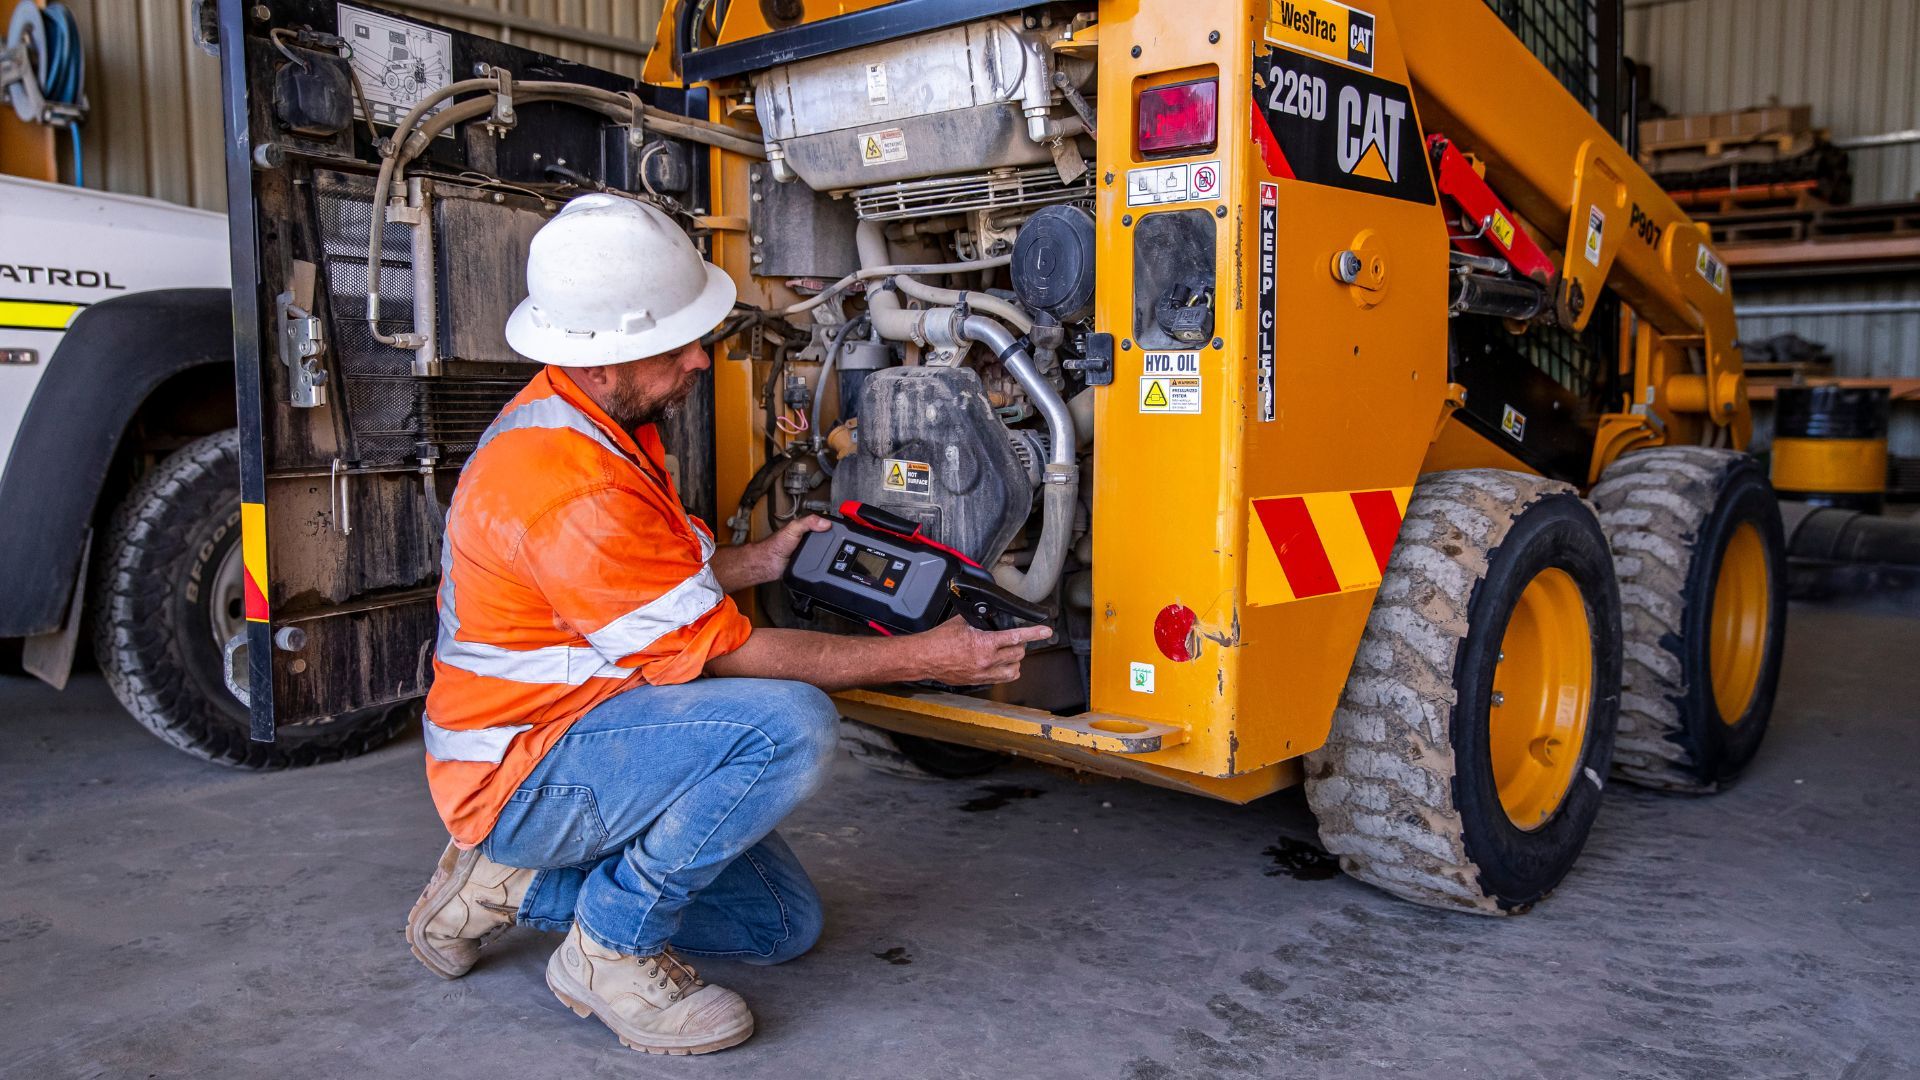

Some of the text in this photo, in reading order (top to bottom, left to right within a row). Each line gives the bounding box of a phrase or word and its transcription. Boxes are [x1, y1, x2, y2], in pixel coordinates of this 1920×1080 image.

[1281, 1, 1337, 43] WesTrac
[1350, 24, 1373, 54] CAT
[1268, 66, 1327, 121] 226D
[1337, 85, 1406, 183] CAT
[1629, 202, 1662, 251] P907
[1262, 210, 1274, 295] KEEP
[1145, 354, 1197, 372] HYD. OIL
[907, 478, 928, 486] SURFACE
